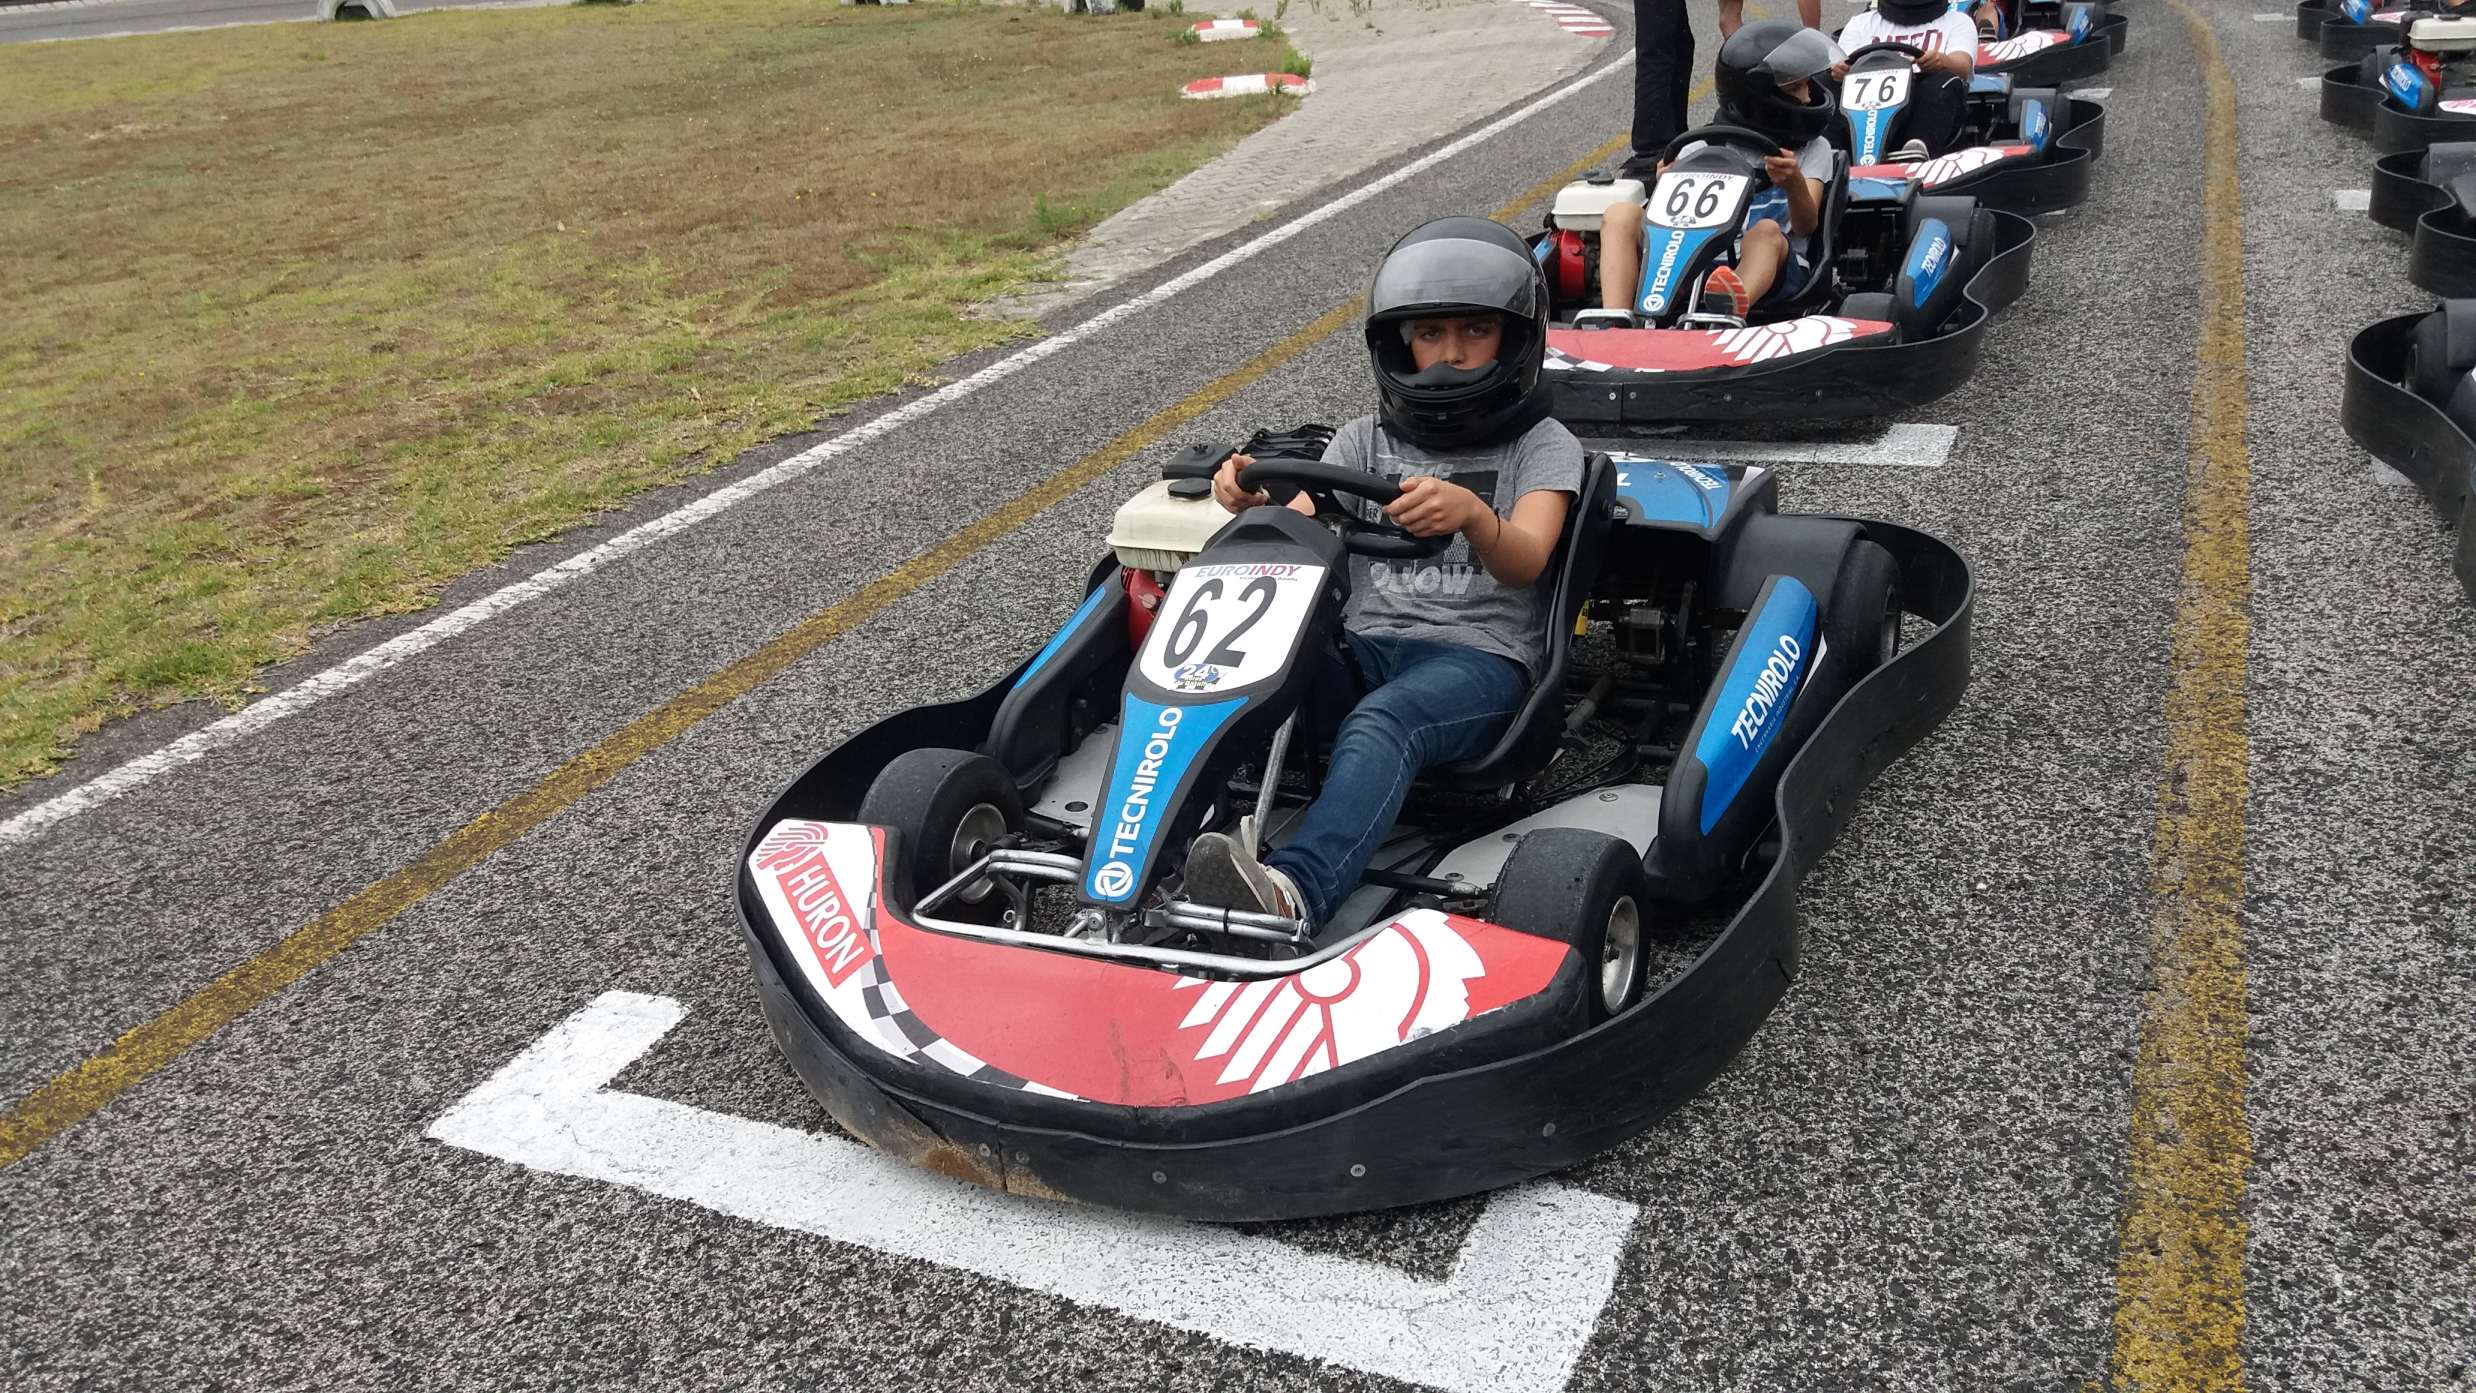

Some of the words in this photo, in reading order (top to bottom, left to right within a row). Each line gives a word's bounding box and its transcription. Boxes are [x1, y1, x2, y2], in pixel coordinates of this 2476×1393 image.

[1854, 75, 1897, 104] 76
[1666, 178, 1725, 218] 66
[1651, 231, 1686, 292] TECNIROLO
[1195, 565, 1302, 578] EUROINDY
[1163, 576, 1277, 668] 62
[1731, 634, 1800, 751] TECNIROLO
[1109, 707, 1183, 858] TECNIROLO
[787, 865, 864, 974] HURON
